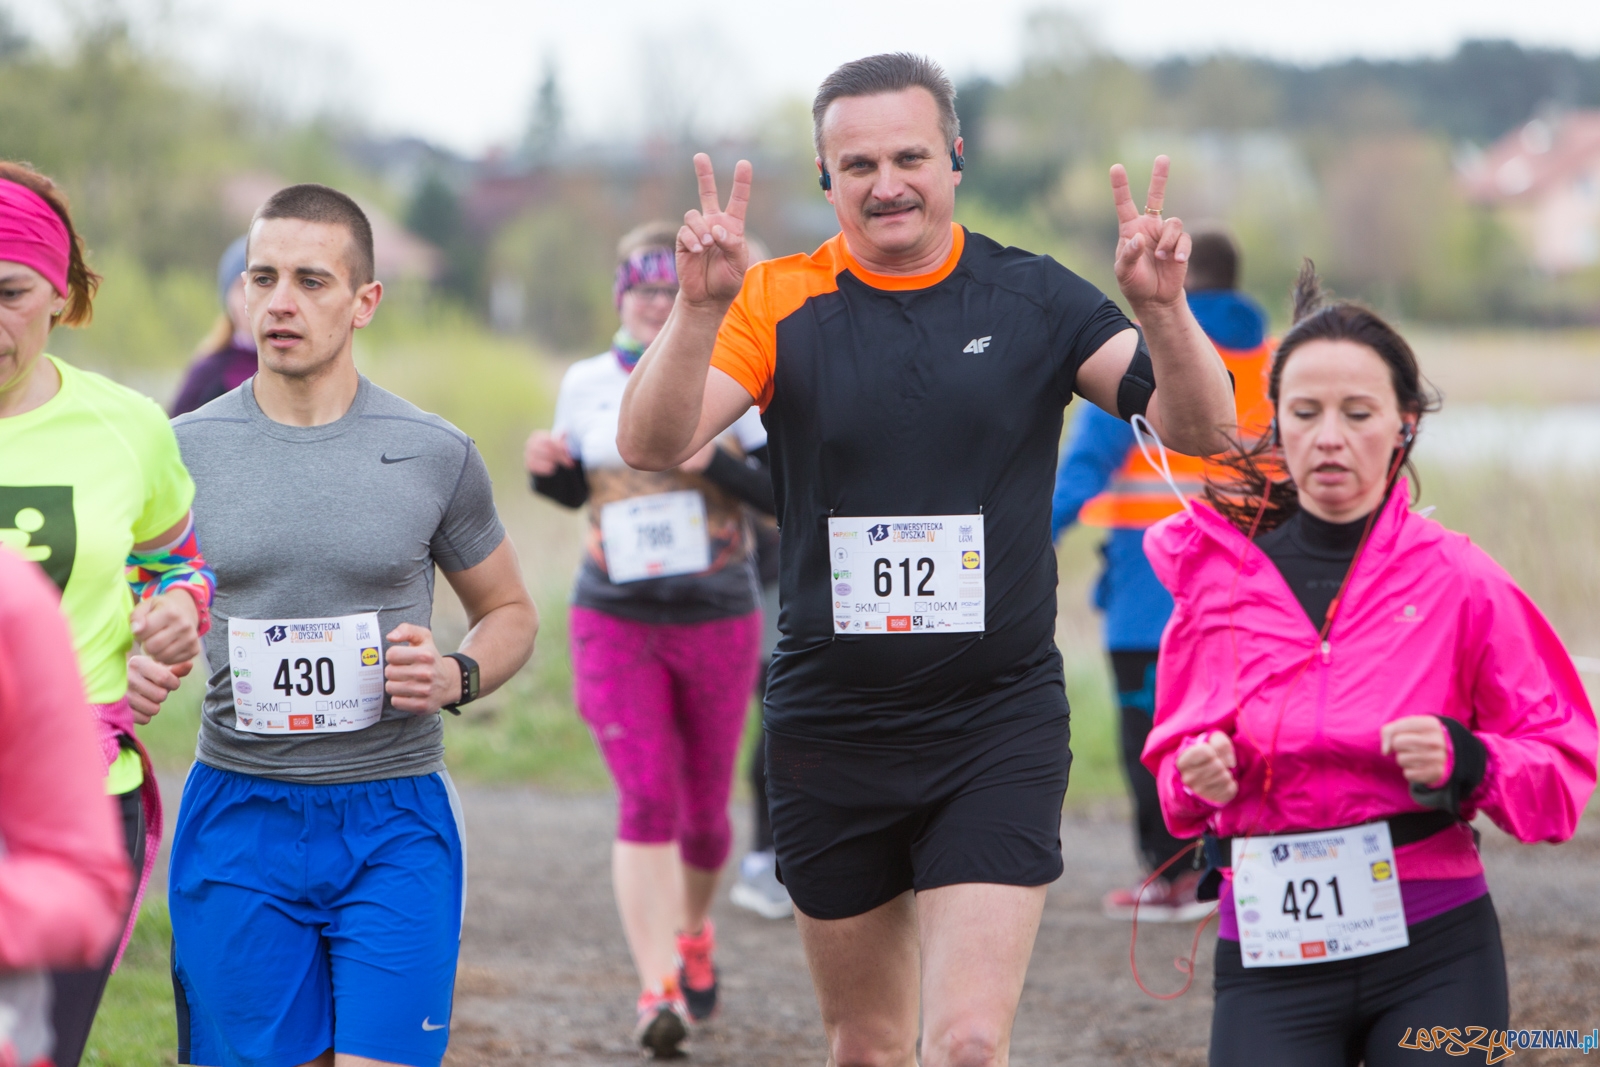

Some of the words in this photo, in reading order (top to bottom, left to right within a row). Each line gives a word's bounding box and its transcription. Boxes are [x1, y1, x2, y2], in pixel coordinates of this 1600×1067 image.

[963, 335, 992, 354] 4F
[893, 522, 943, 531] UNIWERSYTECKA
[893, 530, 925, 539] ZADYSZKA
[927, 530, 935, 542] IV
[873, 557, 935, 597] 612
[855, 603, 877, 612] 5KM
[928, 601, 958, 611] 10KM
[289, 622, 341, 632] UNIWERSYTECKA
[290, 631, 324, 641] ZADYSZKA
[324, 631, 333, 642] IV
[273, 657, 335, 697] 430
[256, 702, 278, 712] 5KM
[328, 698, 359, 710] 10KM
[1282, 876, 1344, 922] 421
